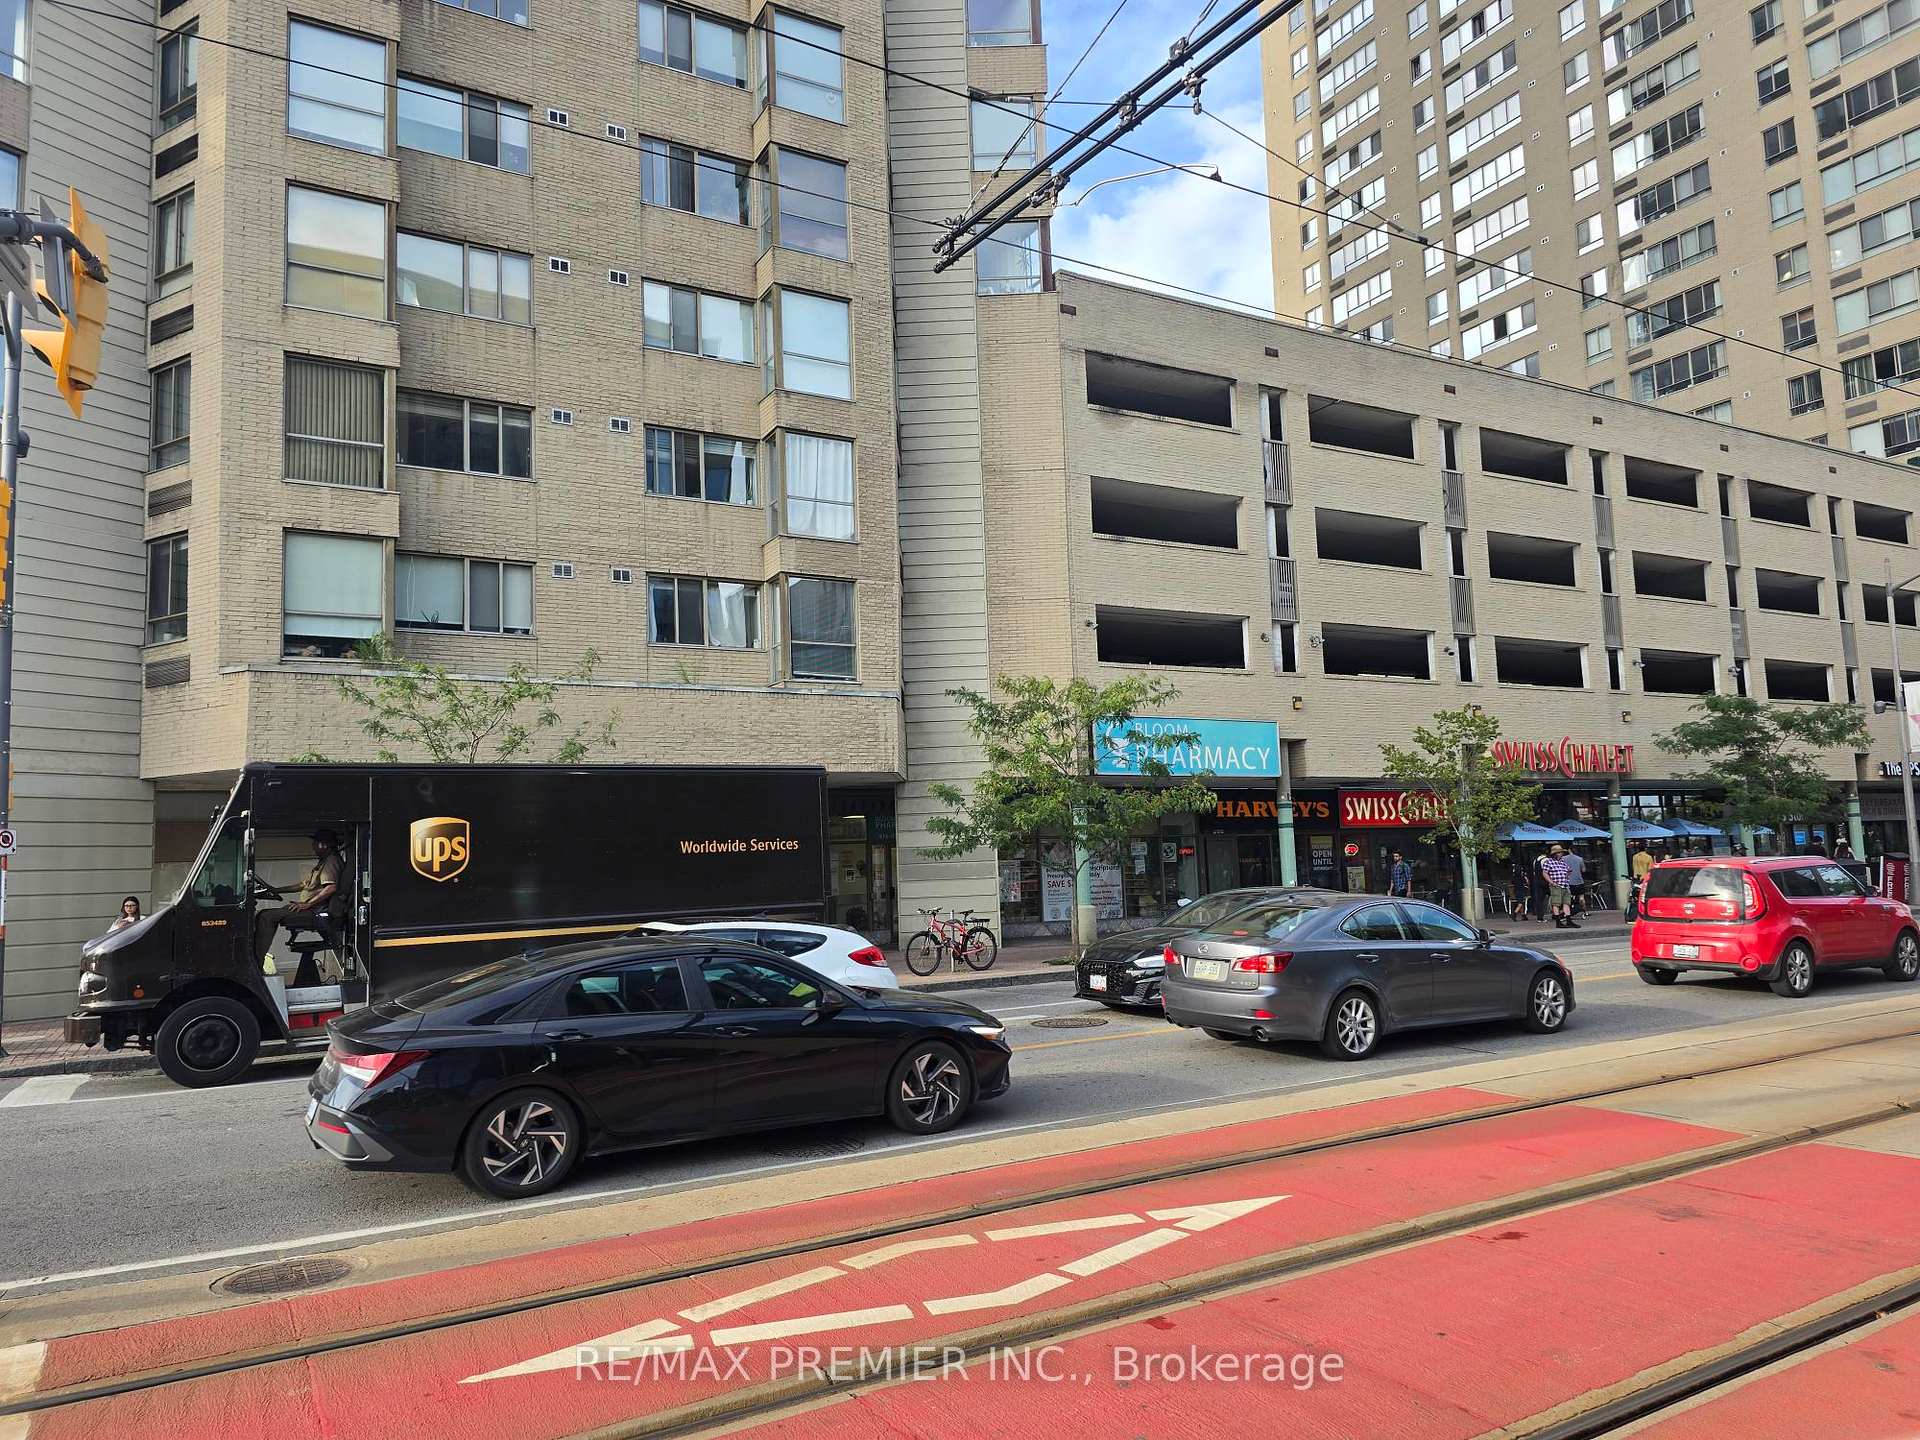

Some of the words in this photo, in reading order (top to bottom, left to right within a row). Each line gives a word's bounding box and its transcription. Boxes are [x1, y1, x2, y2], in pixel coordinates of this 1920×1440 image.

[1135, 723, 1188, 737] BLOOM
[1136, 743, 1271, 770] PHARMACY
[1885, 761, 1902, 776] The
[680, 839, 747, 854] Worldwide
[750, 838, 799, 852] Services
[415, 836, 466, 872] ups
[1312, 858, 1334, 866] UNTIL
[1047, 880, 1066, 888] SAVE
